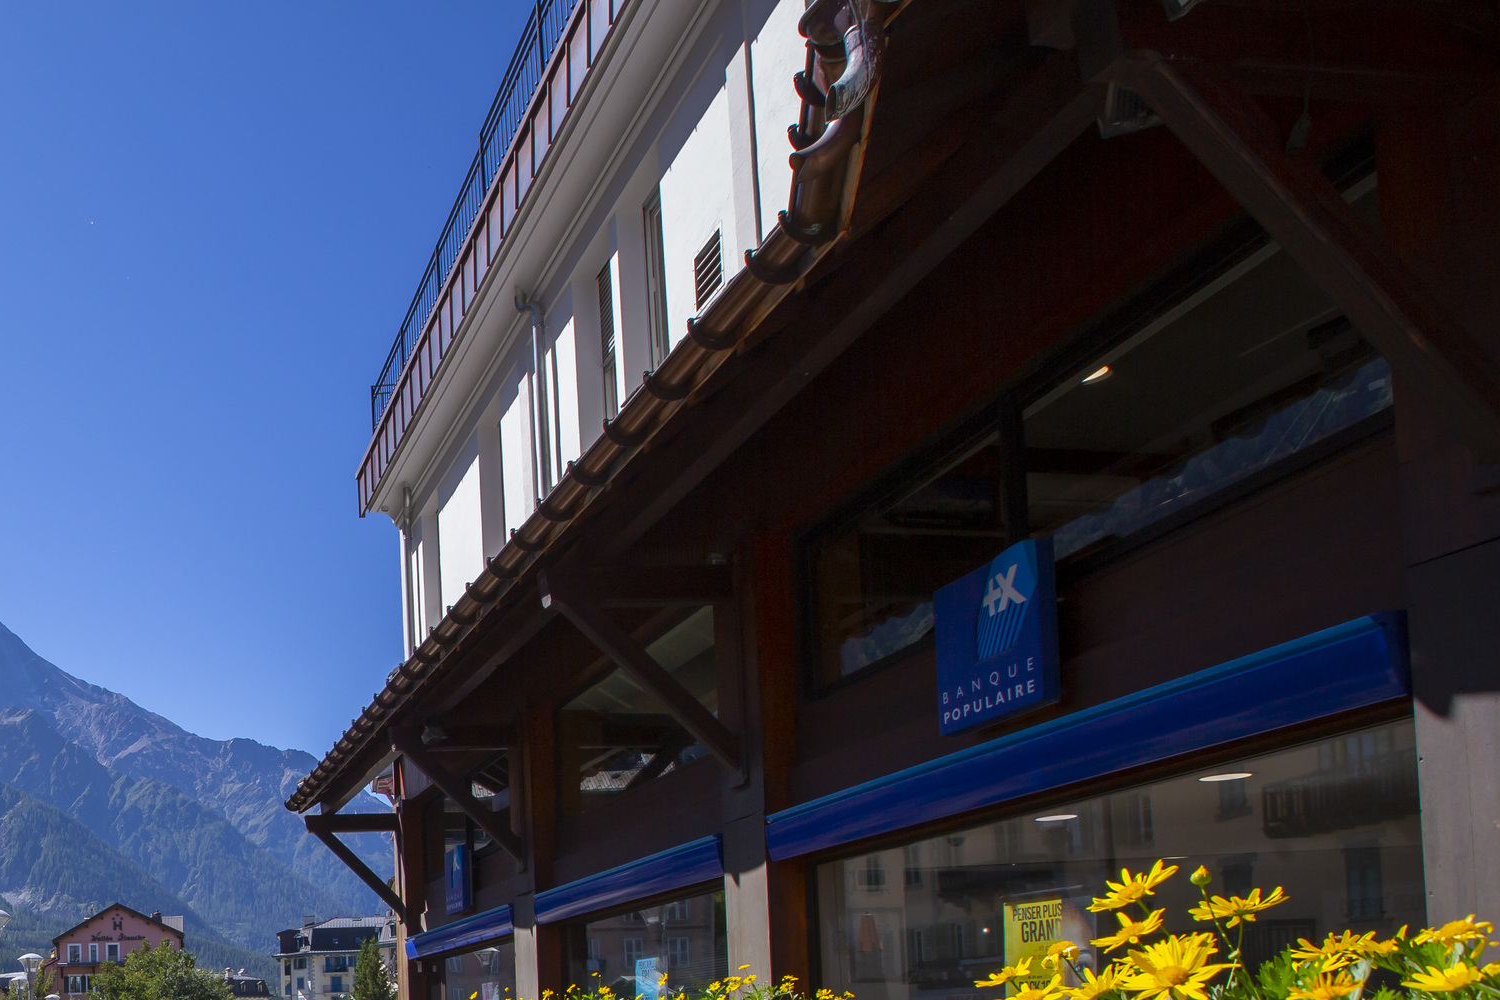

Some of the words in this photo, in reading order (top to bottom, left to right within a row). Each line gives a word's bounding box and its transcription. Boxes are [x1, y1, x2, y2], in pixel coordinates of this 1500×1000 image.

[942, 656, 1035, 705] BANQUE
[943, 679, 1036, 725] POPULAIRE
[1012, 905, 1041, 922] PENSER
[1043, 902, 1062, 918] PLUS
[1021, 918, 1062, 943] GRAND
